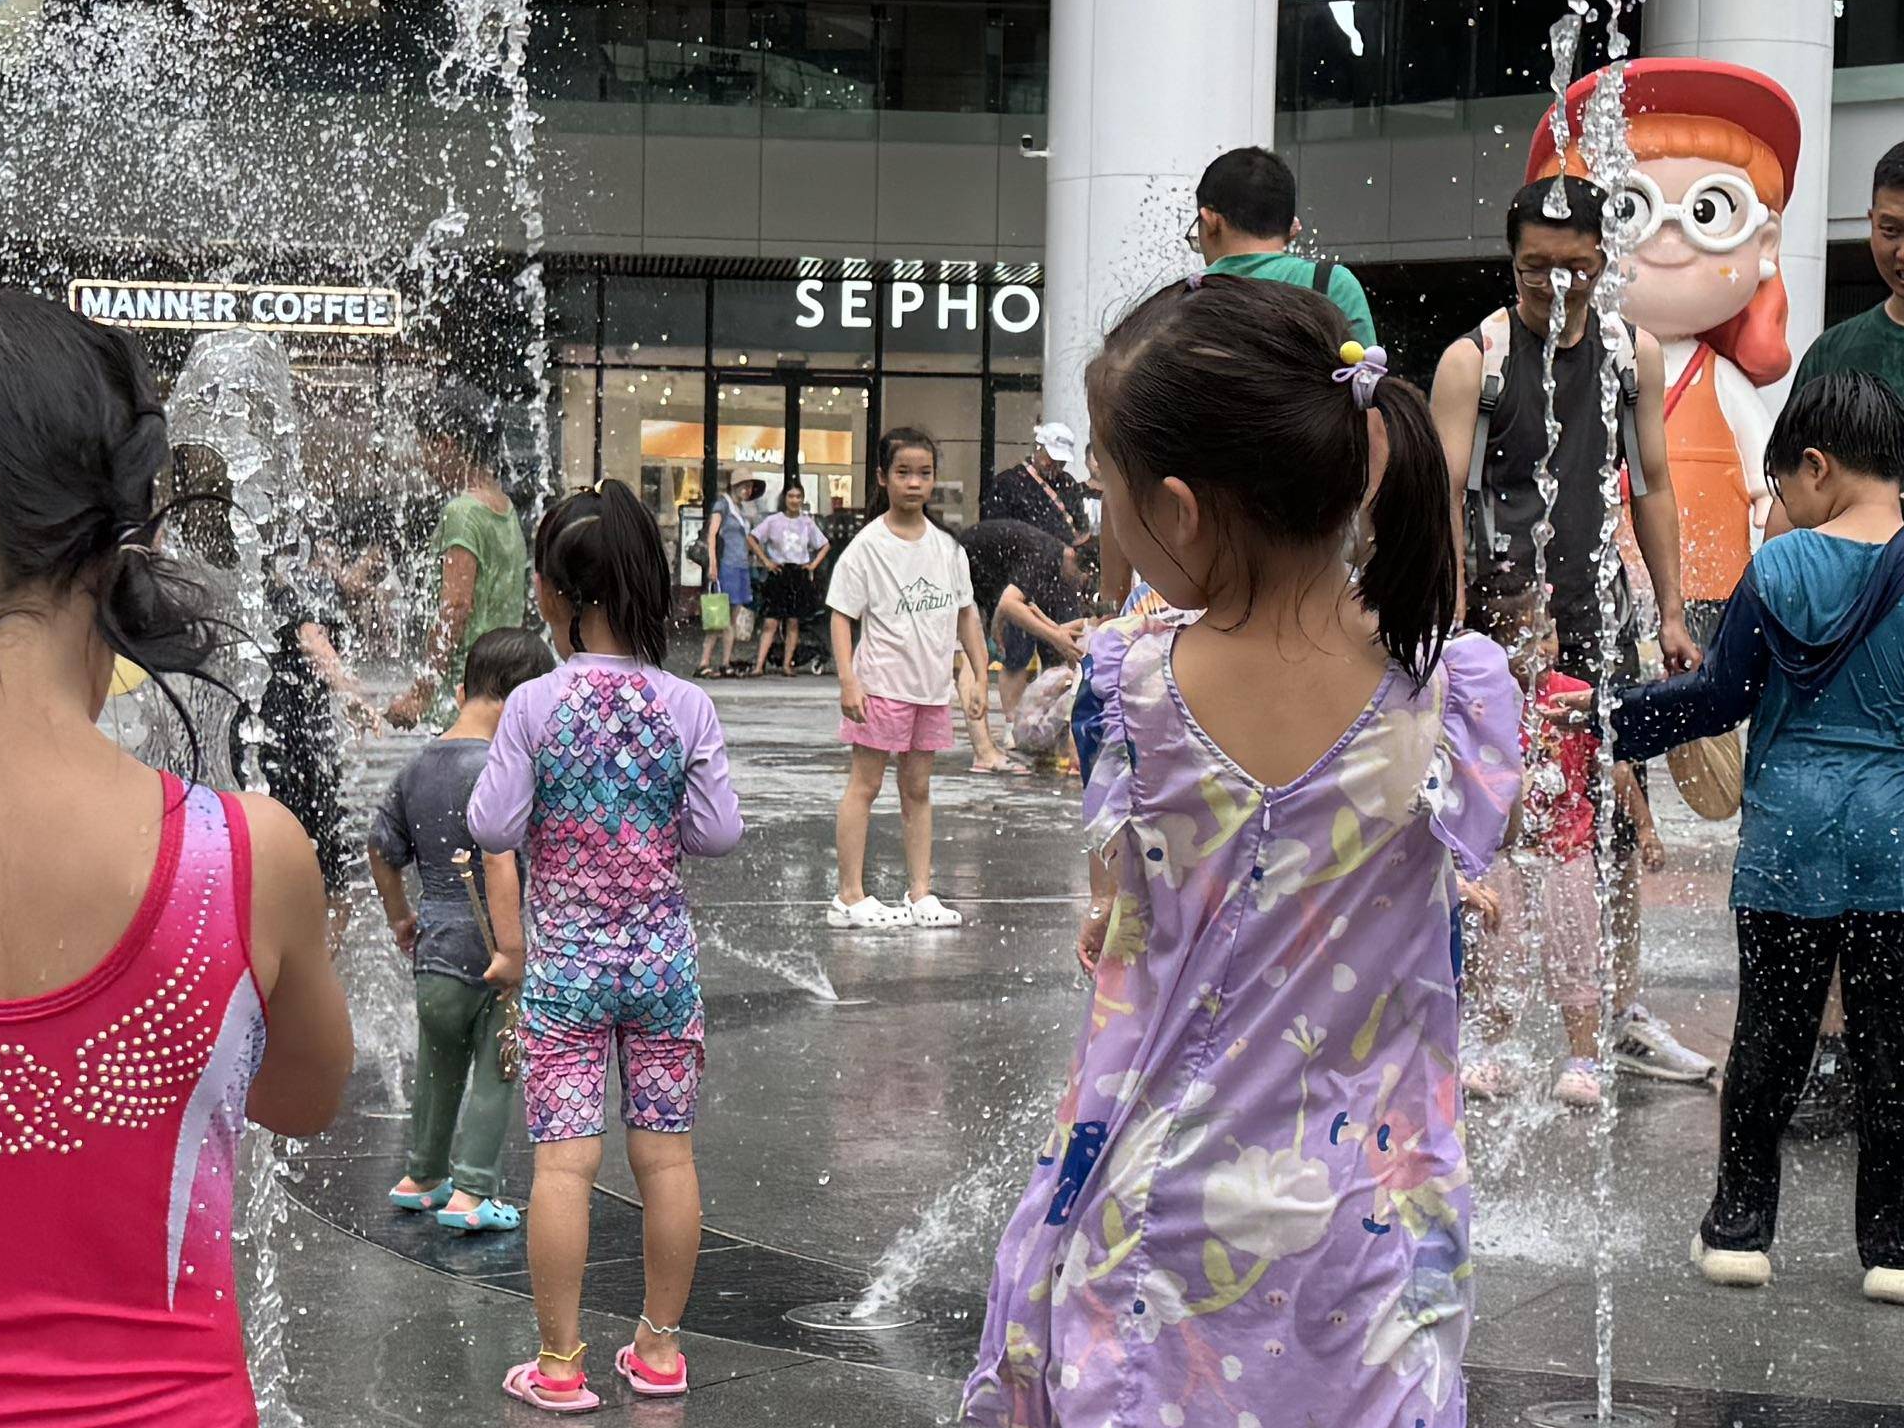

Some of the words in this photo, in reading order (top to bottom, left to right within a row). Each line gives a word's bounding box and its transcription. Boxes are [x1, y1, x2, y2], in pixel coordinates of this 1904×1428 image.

[81, 288, 237, 321] MANNER
[252, 292, 389, 325] COFFEE
[795, 279, 1040, 333] SEPHO
